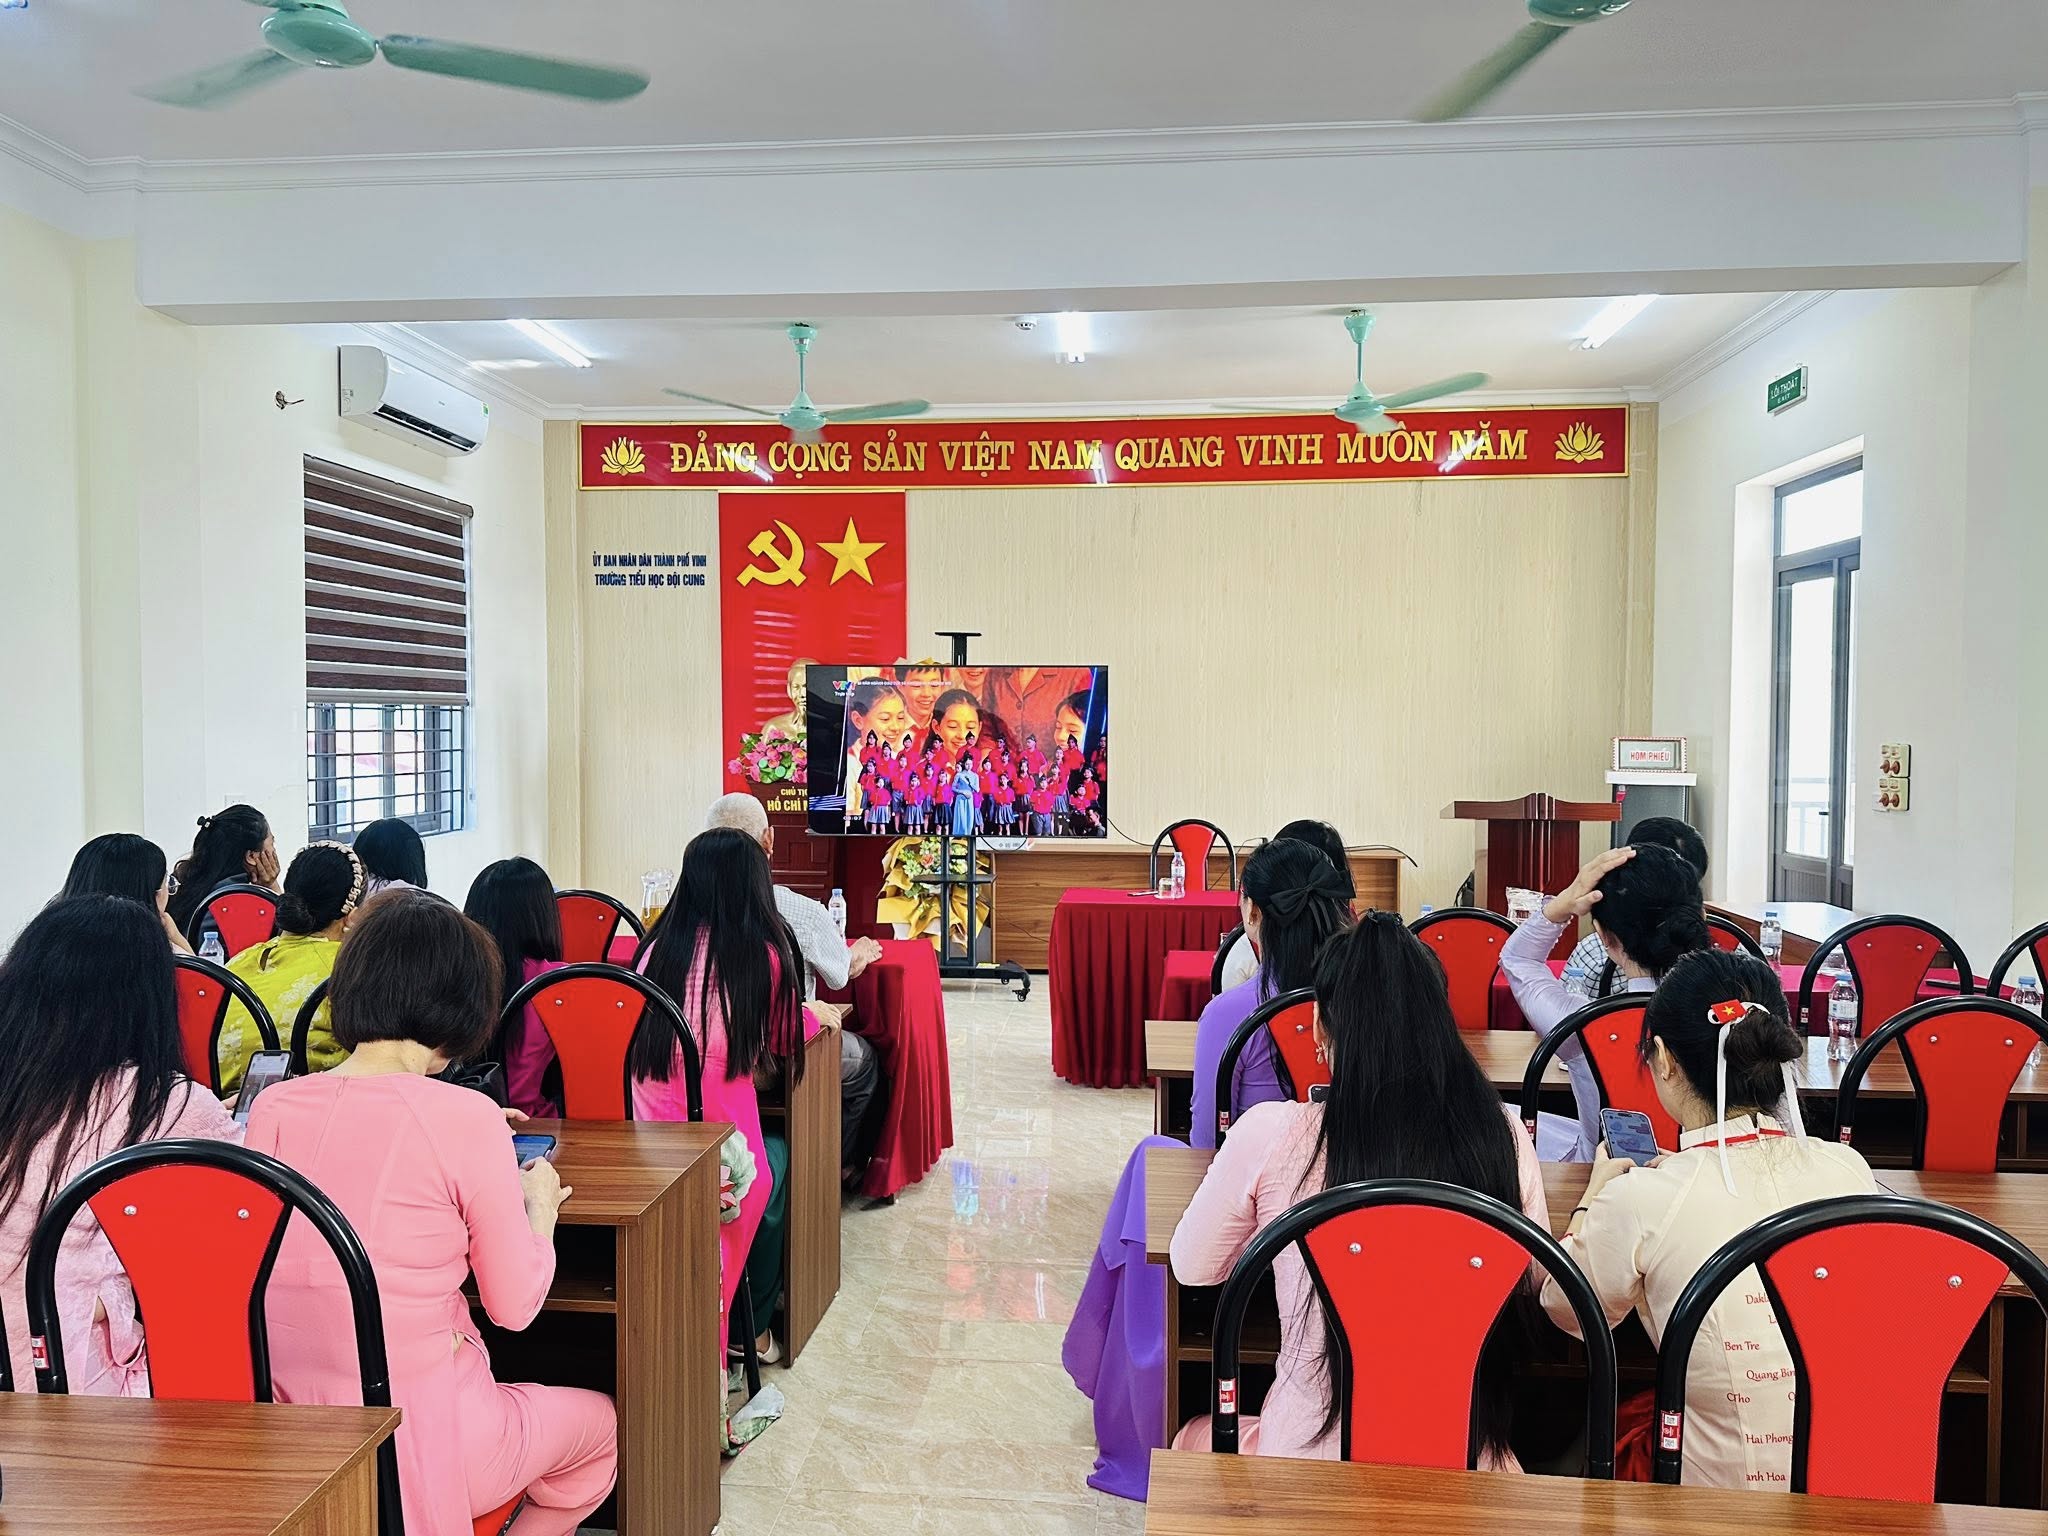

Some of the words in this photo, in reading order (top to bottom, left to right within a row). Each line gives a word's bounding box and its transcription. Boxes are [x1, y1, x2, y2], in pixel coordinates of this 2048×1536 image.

[670, 430, 758, 473] ĐẢNG
[863, 429, 928, 472] SẢN
[938, 430, 1015, 478] VIỆT
[1028, 439, 1103, 471] NAM
[1114, 436, 1225, 472] QUANG
[1235, 432, 1324, 468] VINH
[1336, 420, 1437, 464] MUÔN
[1447, 420, 1529, 462] NĂM
[603, 554, 617, 567] BAN
[628, 569, 646, 586] TIỂU
[648, 574, 665, 588] HỌC
[682, 574, 706, 586] CUNG
[783, 797, 802, 811] CHÍ
[1724, 1341, 1743, 1351] Ben
[1744, 1340, 1760, 1350] Tre
[1746, 1369, 1779, 1382] Quang
[1780, 1367, 1795, 1378] Bin
[1745, 1433, 1763, 1444] Hai
[1765, 1433, 1793, 1444] Phong
[1766, 1471, 1786, 1482] Hoa
